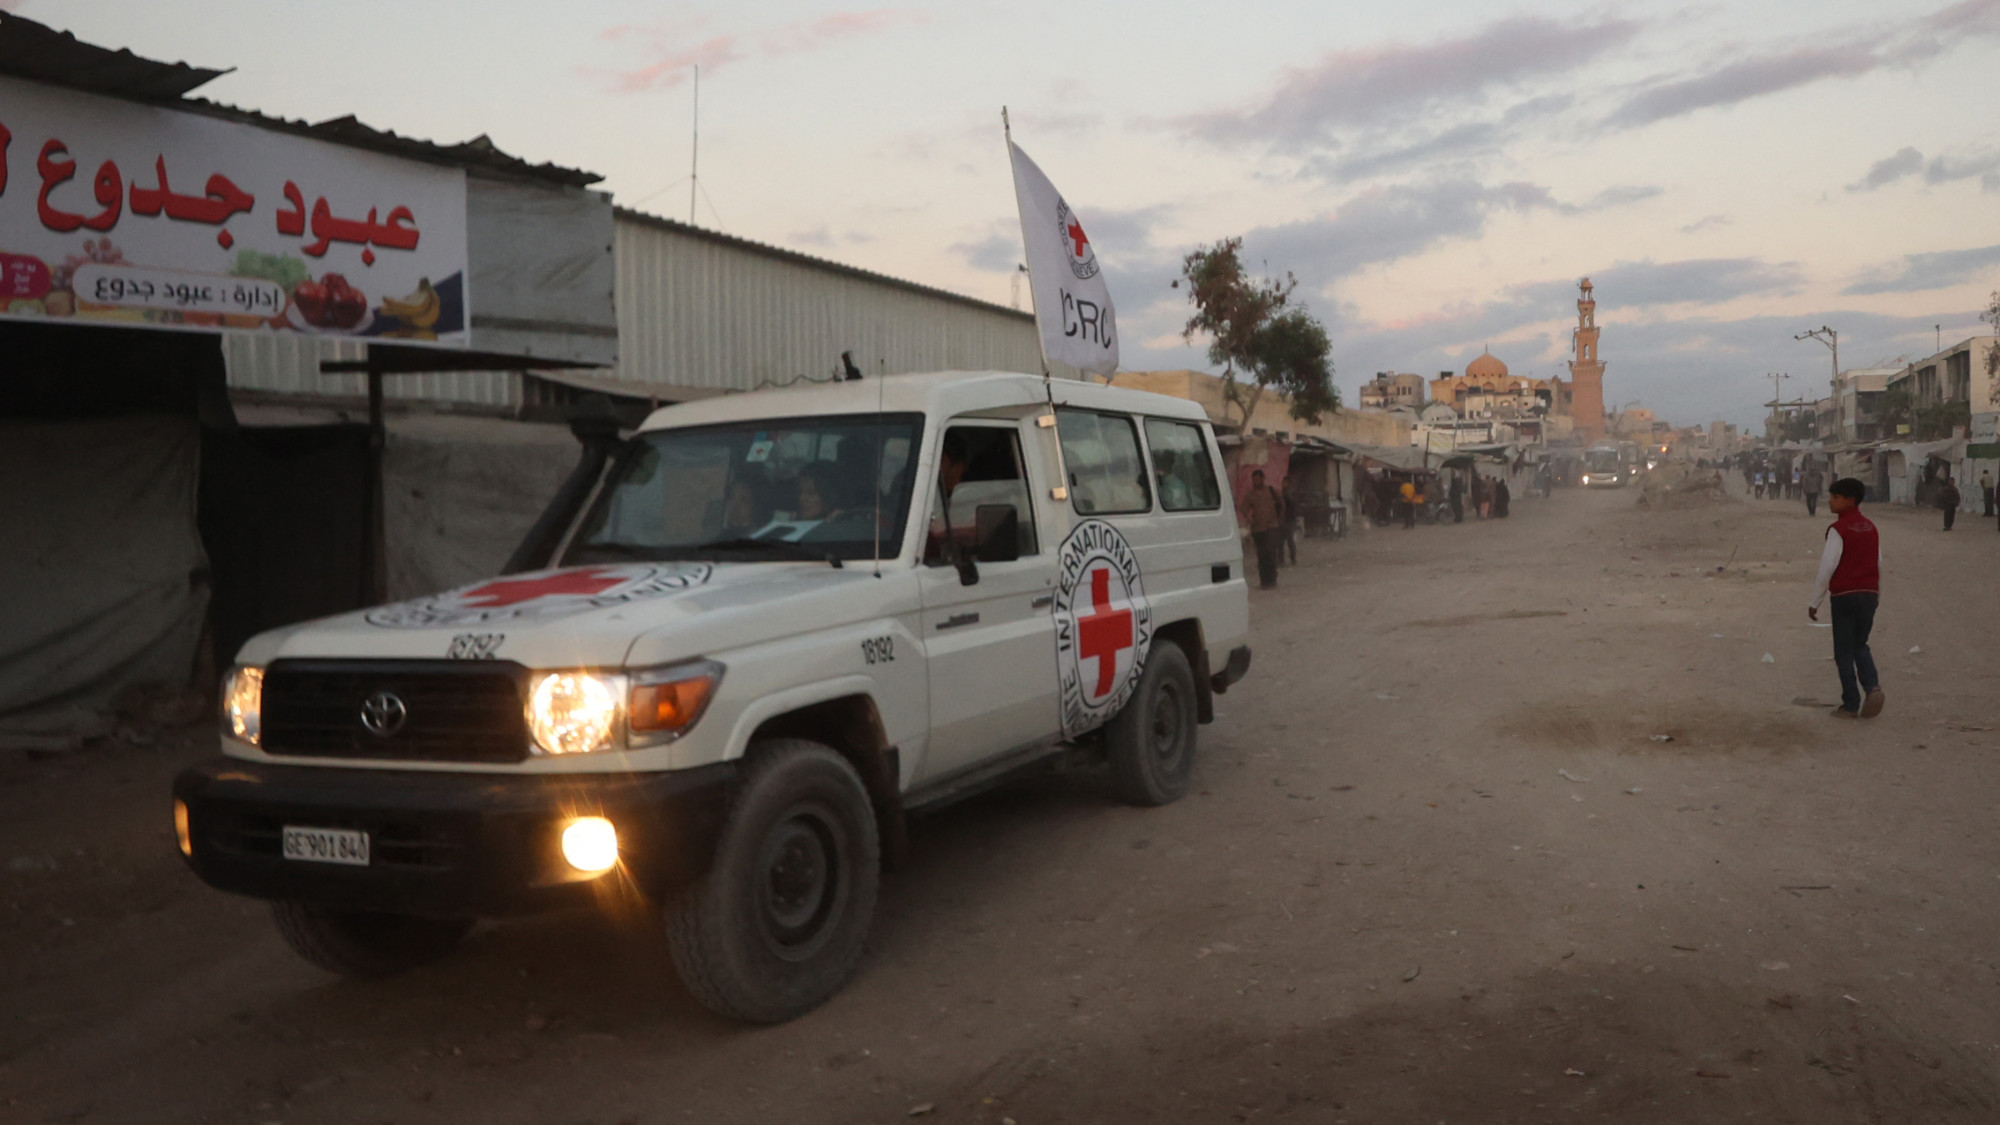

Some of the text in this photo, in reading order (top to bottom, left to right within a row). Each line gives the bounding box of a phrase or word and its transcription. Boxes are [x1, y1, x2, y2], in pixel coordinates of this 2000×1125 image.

[36, 139, 255, 249] جدوع
[276, 179, 420, 266] عبود
[95, 277, 155, 303] جدوع
[163, 282, 213, 306] عبود
[234, 285, 279, 312] إدارة
[1055, 524, 1139, 652] INTERNATIONAL
[861, 635, 895, 665] 18192
